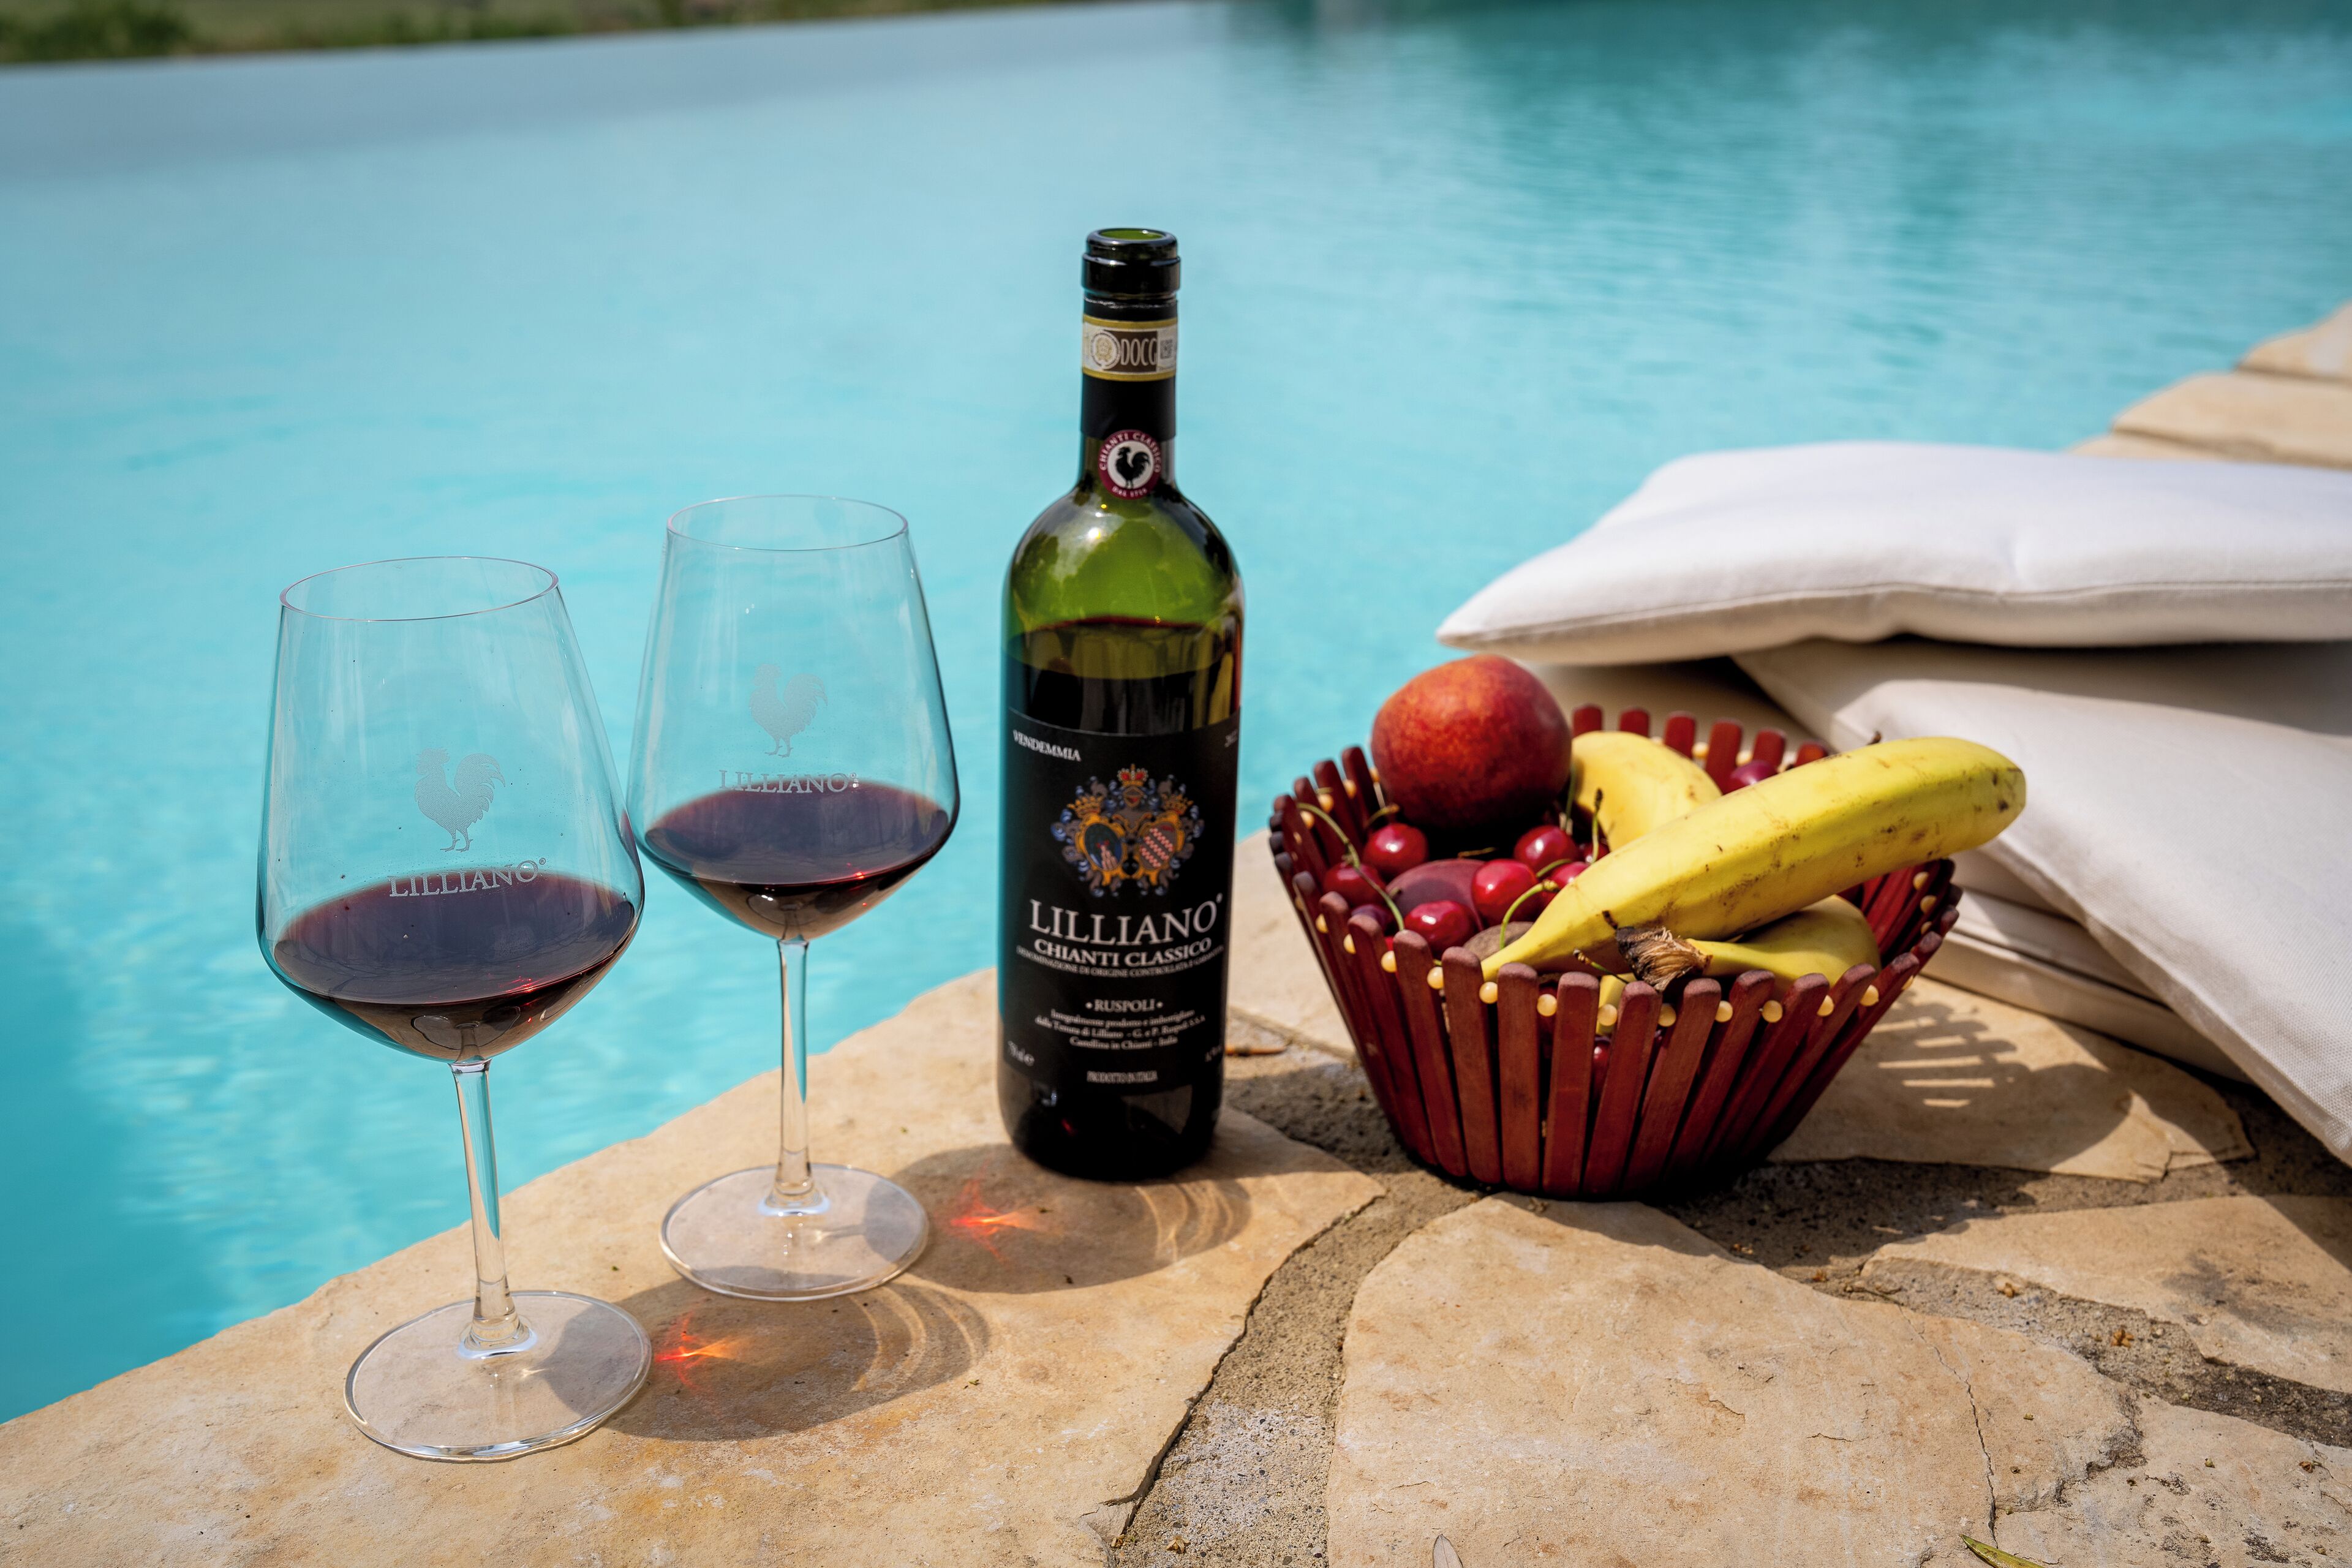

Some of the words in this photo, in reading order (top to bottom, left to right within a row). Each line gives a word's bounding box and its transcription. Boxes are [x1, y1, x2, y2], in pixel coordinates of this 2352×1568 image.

[1120, 338, 1156, 366] DOCG
[1099, 432, 1129, 471] CHIANTI
[1133, 432, 1161, 473] CLASSICO
[1012, 729, 1082, 762] VENDEMMIA
[1034, 938, 1120, 967] CHIANTI
[1124, 937, 1212, 967] CLASSICO
[1090, 967, 1128, 978] ORIGINE
